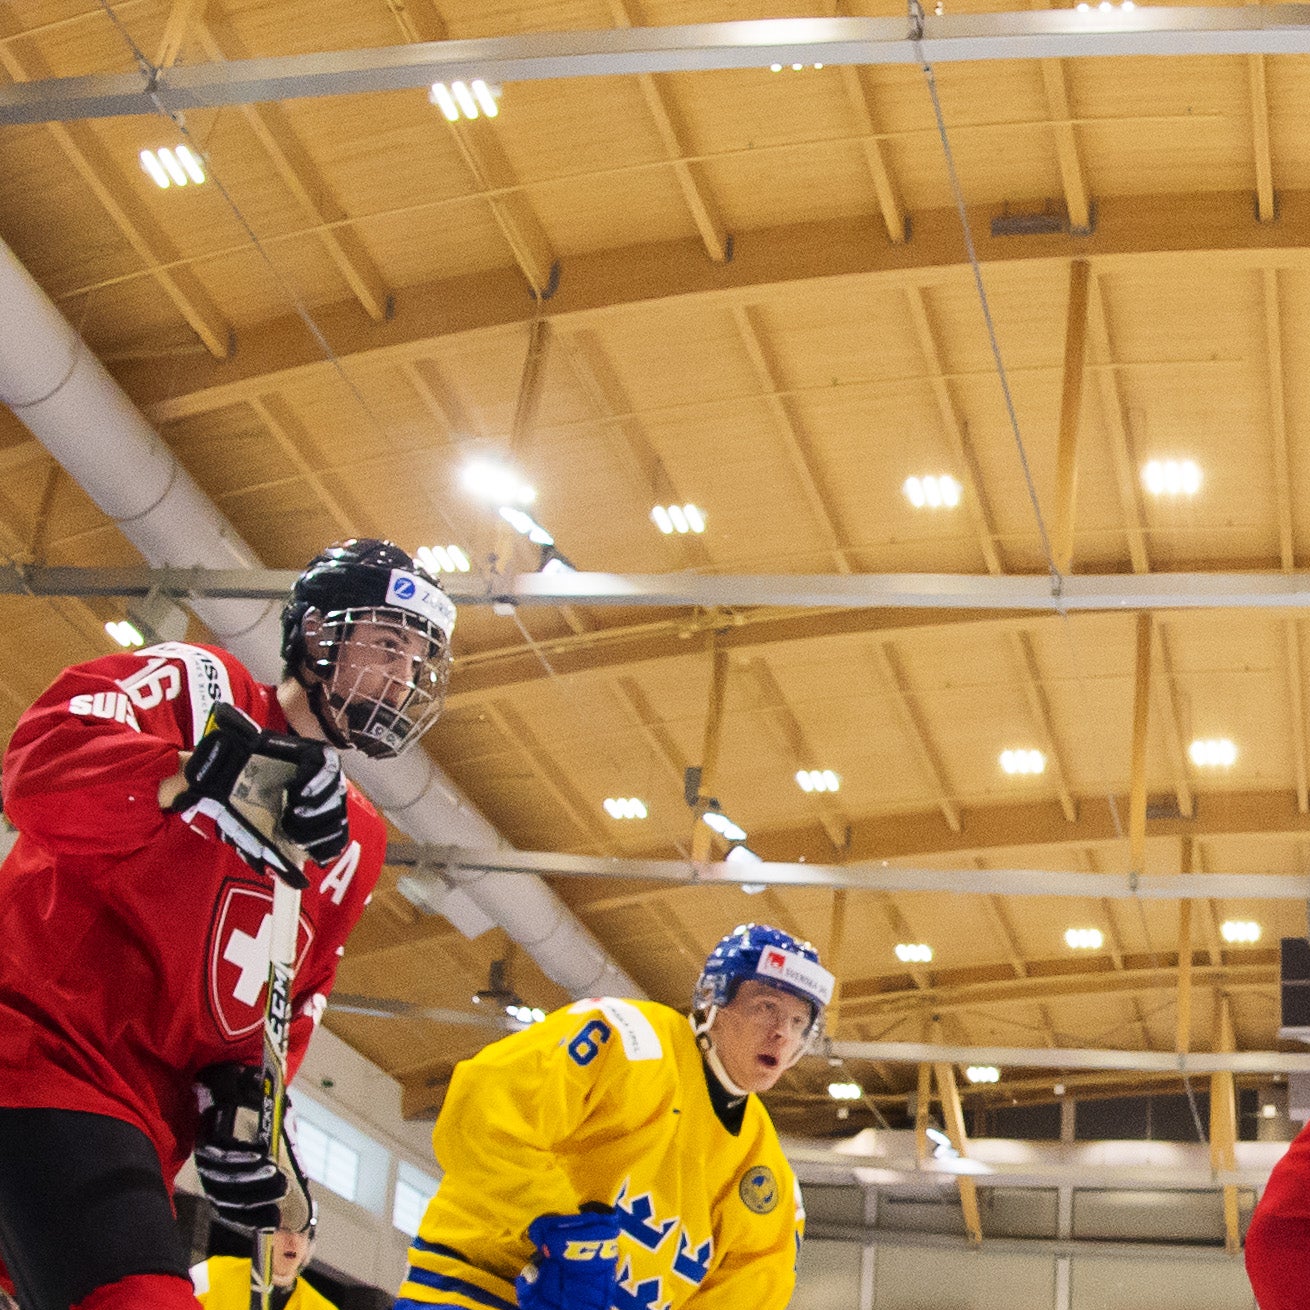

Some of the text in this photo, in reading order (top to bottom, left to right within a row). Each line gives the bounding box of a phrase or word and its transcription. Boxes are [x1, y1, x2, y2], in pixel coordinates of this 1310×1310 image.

[114, 658, 181, 710] 16
[319, 840, 361, 905] A
[568, 1019, 611, 1066] 6
